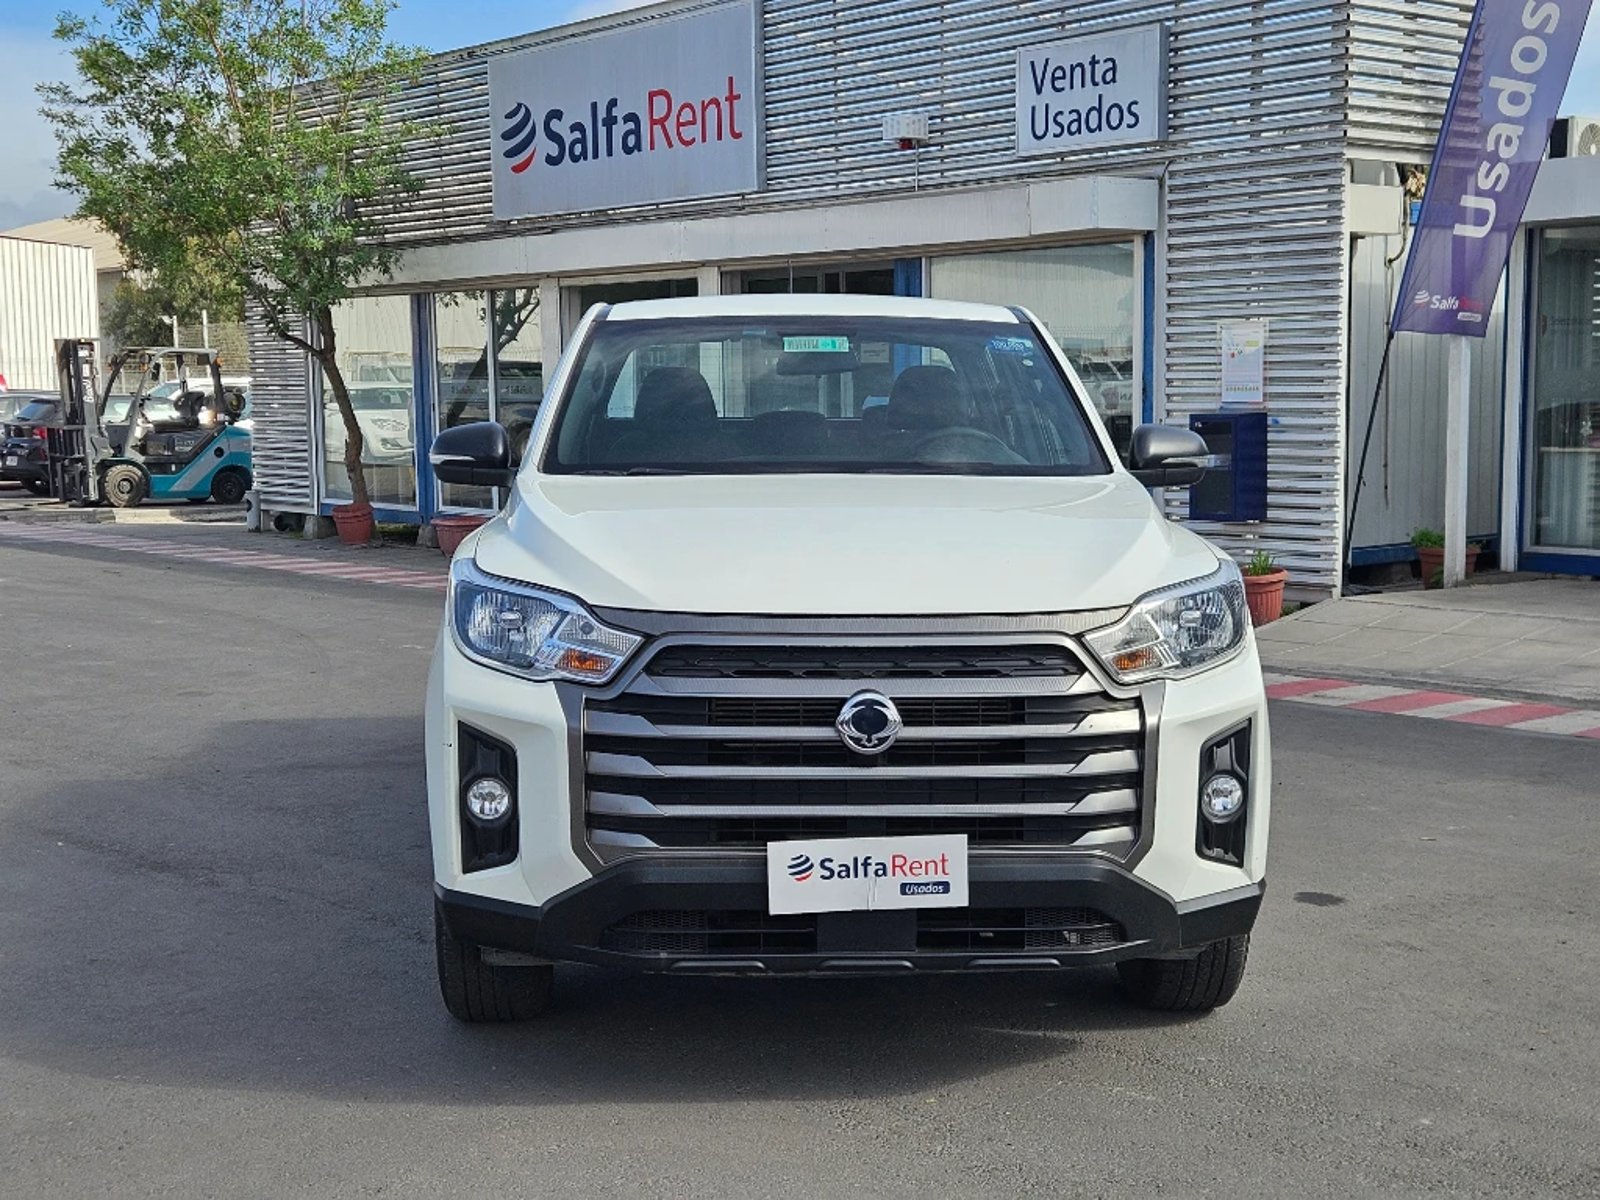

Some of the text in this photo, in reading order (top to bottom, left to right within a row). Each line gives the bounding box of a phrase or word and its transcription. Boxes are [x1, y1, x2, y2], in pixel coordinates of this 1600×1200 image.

[1030, 54, 1117, 95] Venta
[543, 76, 743, 166] SalfaRent
[1031, 94, 1140, 141] Usados
[1453, 0, 1560, 239] Usados
[819, 853, 950, 880] SalfaRent
[905, 882, 944, 894] Usados
